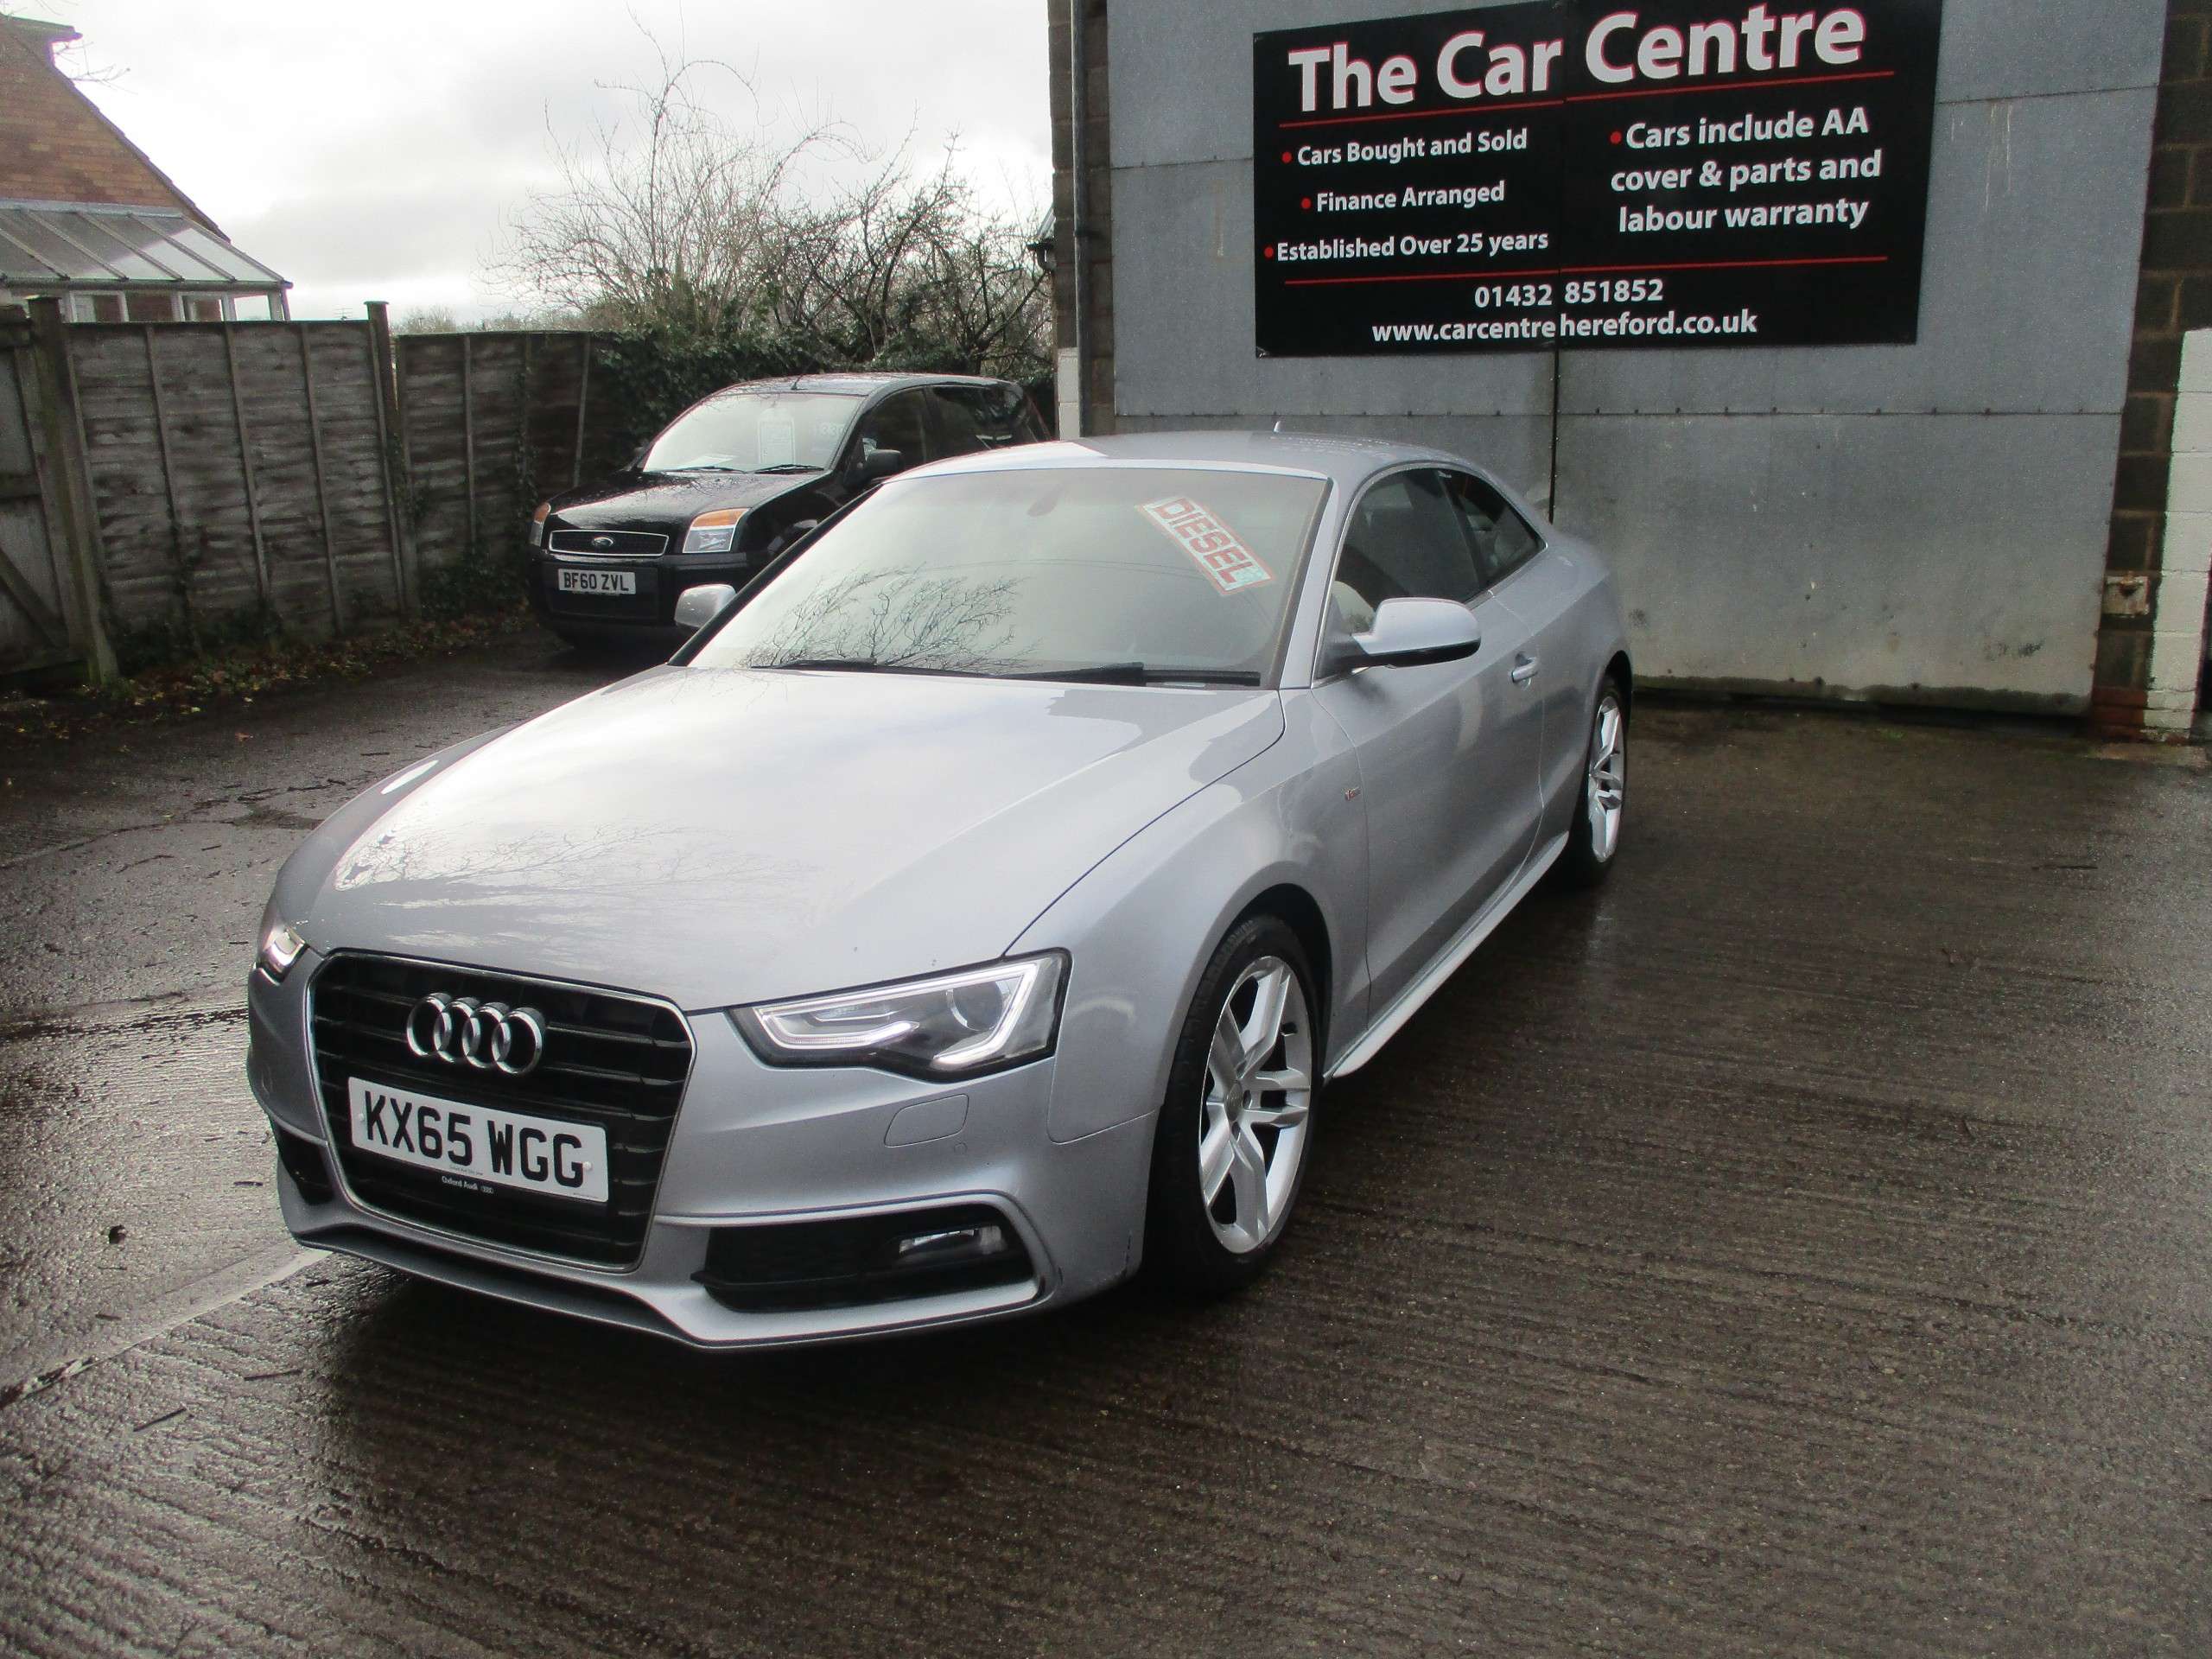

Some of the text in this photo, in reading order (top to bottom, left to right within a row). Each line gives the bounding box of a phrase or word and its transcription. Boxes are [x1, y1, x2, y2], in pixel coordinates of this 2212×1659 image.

[1287, 2, 1866, 112] The Car Centre
[1625, 106, 1869, 149] Cars include AA
[1298, 128, 1528, 166] Cars Bought and Sold
[1611, 149, 1882, 192] cover & parts and
[1317, 180, 1505, 212] Finance Arranged
[1618, 197, 1869, 232] labour warranty
[1277, 232, 1549, 261] Established Over 25 years
[1474, 278, 1664, 308] 01432 851852
[1372, 308, 1758, 341] www.carcentrehereford.co.uk
[1154, 497, 1254, 584] DIESEL
[563, 571, 629, 591] BF60 ZVL
[365, 1090, 584, 1188] KX65 WGG
